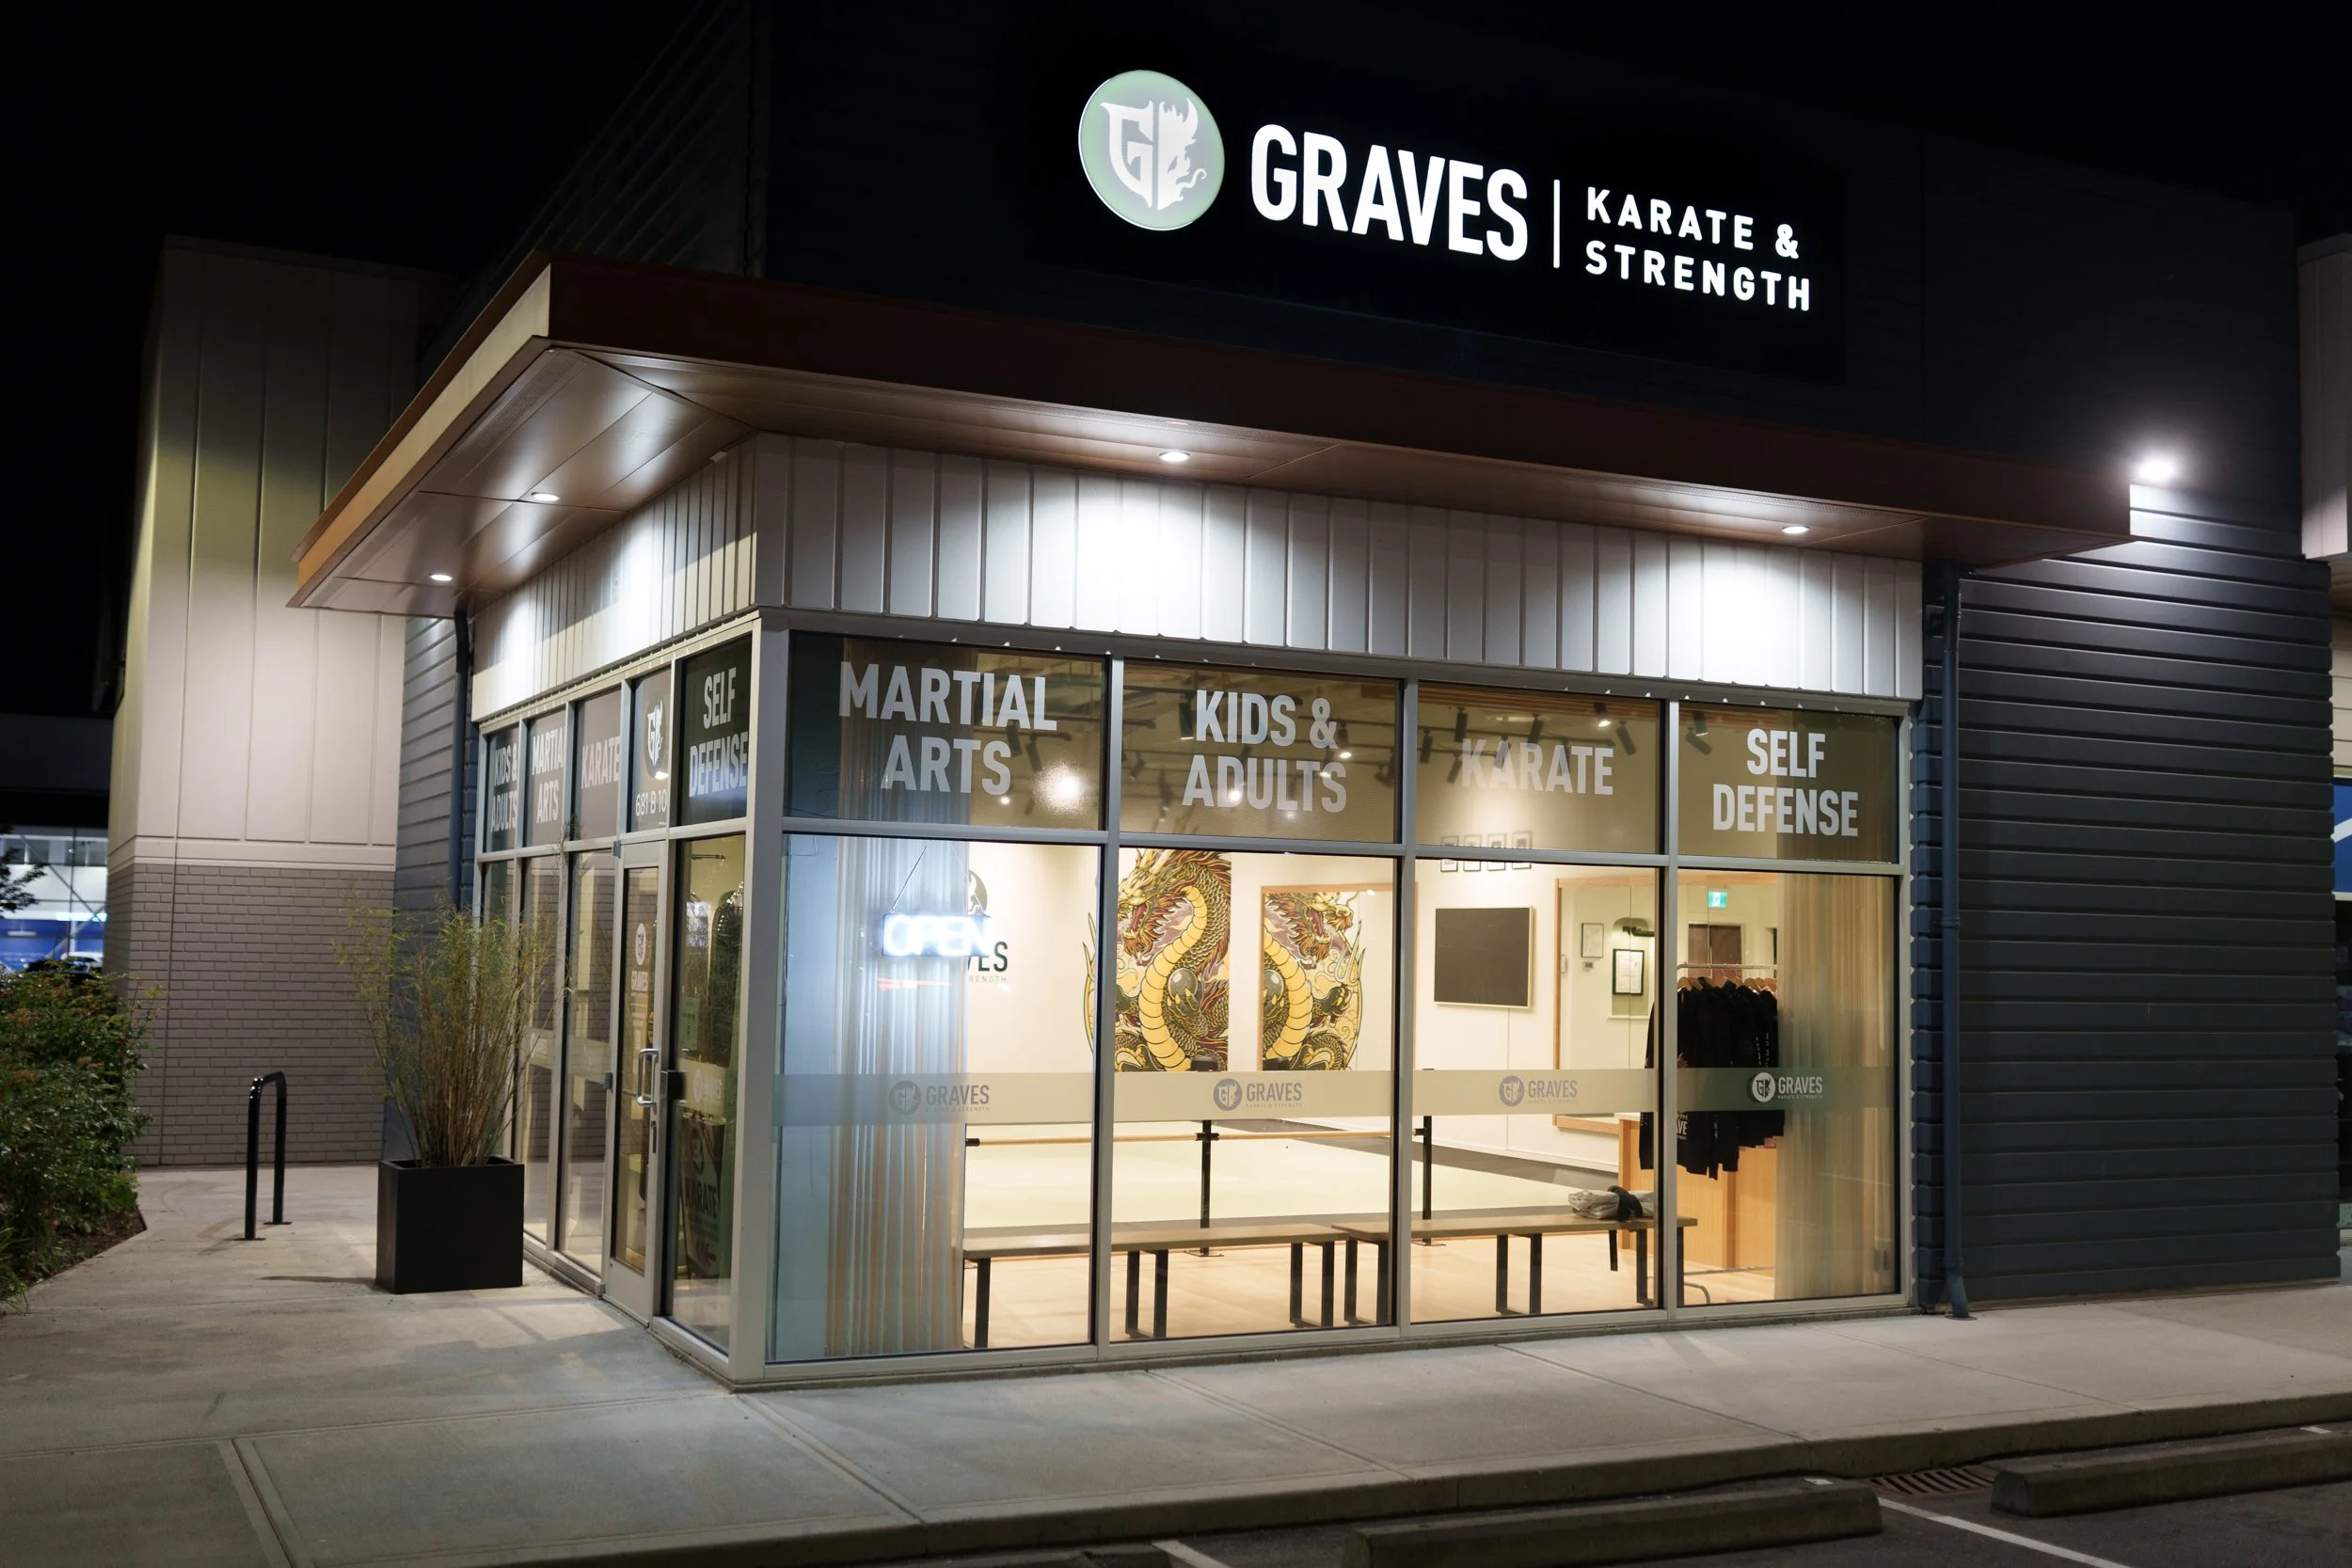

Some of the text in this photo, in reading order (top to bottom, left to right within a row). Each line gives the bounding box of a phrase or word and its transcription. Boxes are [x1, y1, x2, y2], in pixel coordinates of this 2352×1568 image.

[1251, 122, 1529, 262] GRAVES
[1586, 185, 1801, 260] KARATE &
[1585, 240, 1810, 311] STRENGTH
[704, 667, 737, 729] SELF
[839, 661, 1057, 731] MARTIAL
[1196, 689, 1338, 750] KIDS &
[495, 743, 517, 786] KIDS &
[532, 727, 565, 776] MARTIA
[581, 736, 621, 789] KARATE
[689, 732, 749, 798] DEFENSE
[881, 734, 1012, 796] ARTS
[1461, 738, 1614, 796] KARATE
[1747, 727, 1825, 779] SELF
[536, 779, 560, 824] ARTS
[1183, 754, 1348, 813] ADULTS
[491, 790, 517, 832] ADULTS
[1712, 784, 1859, 837] DEFENSE
[883, 914, 989, 956] OPEN
[926, 1085, 990, 1105] GRAVES
[1247, 1083, 1302, 1101] GRAVES
[1528, 1080, 1578, 1098] GRAVES
[1778, 1076, 1823, 1094] GRAVES
